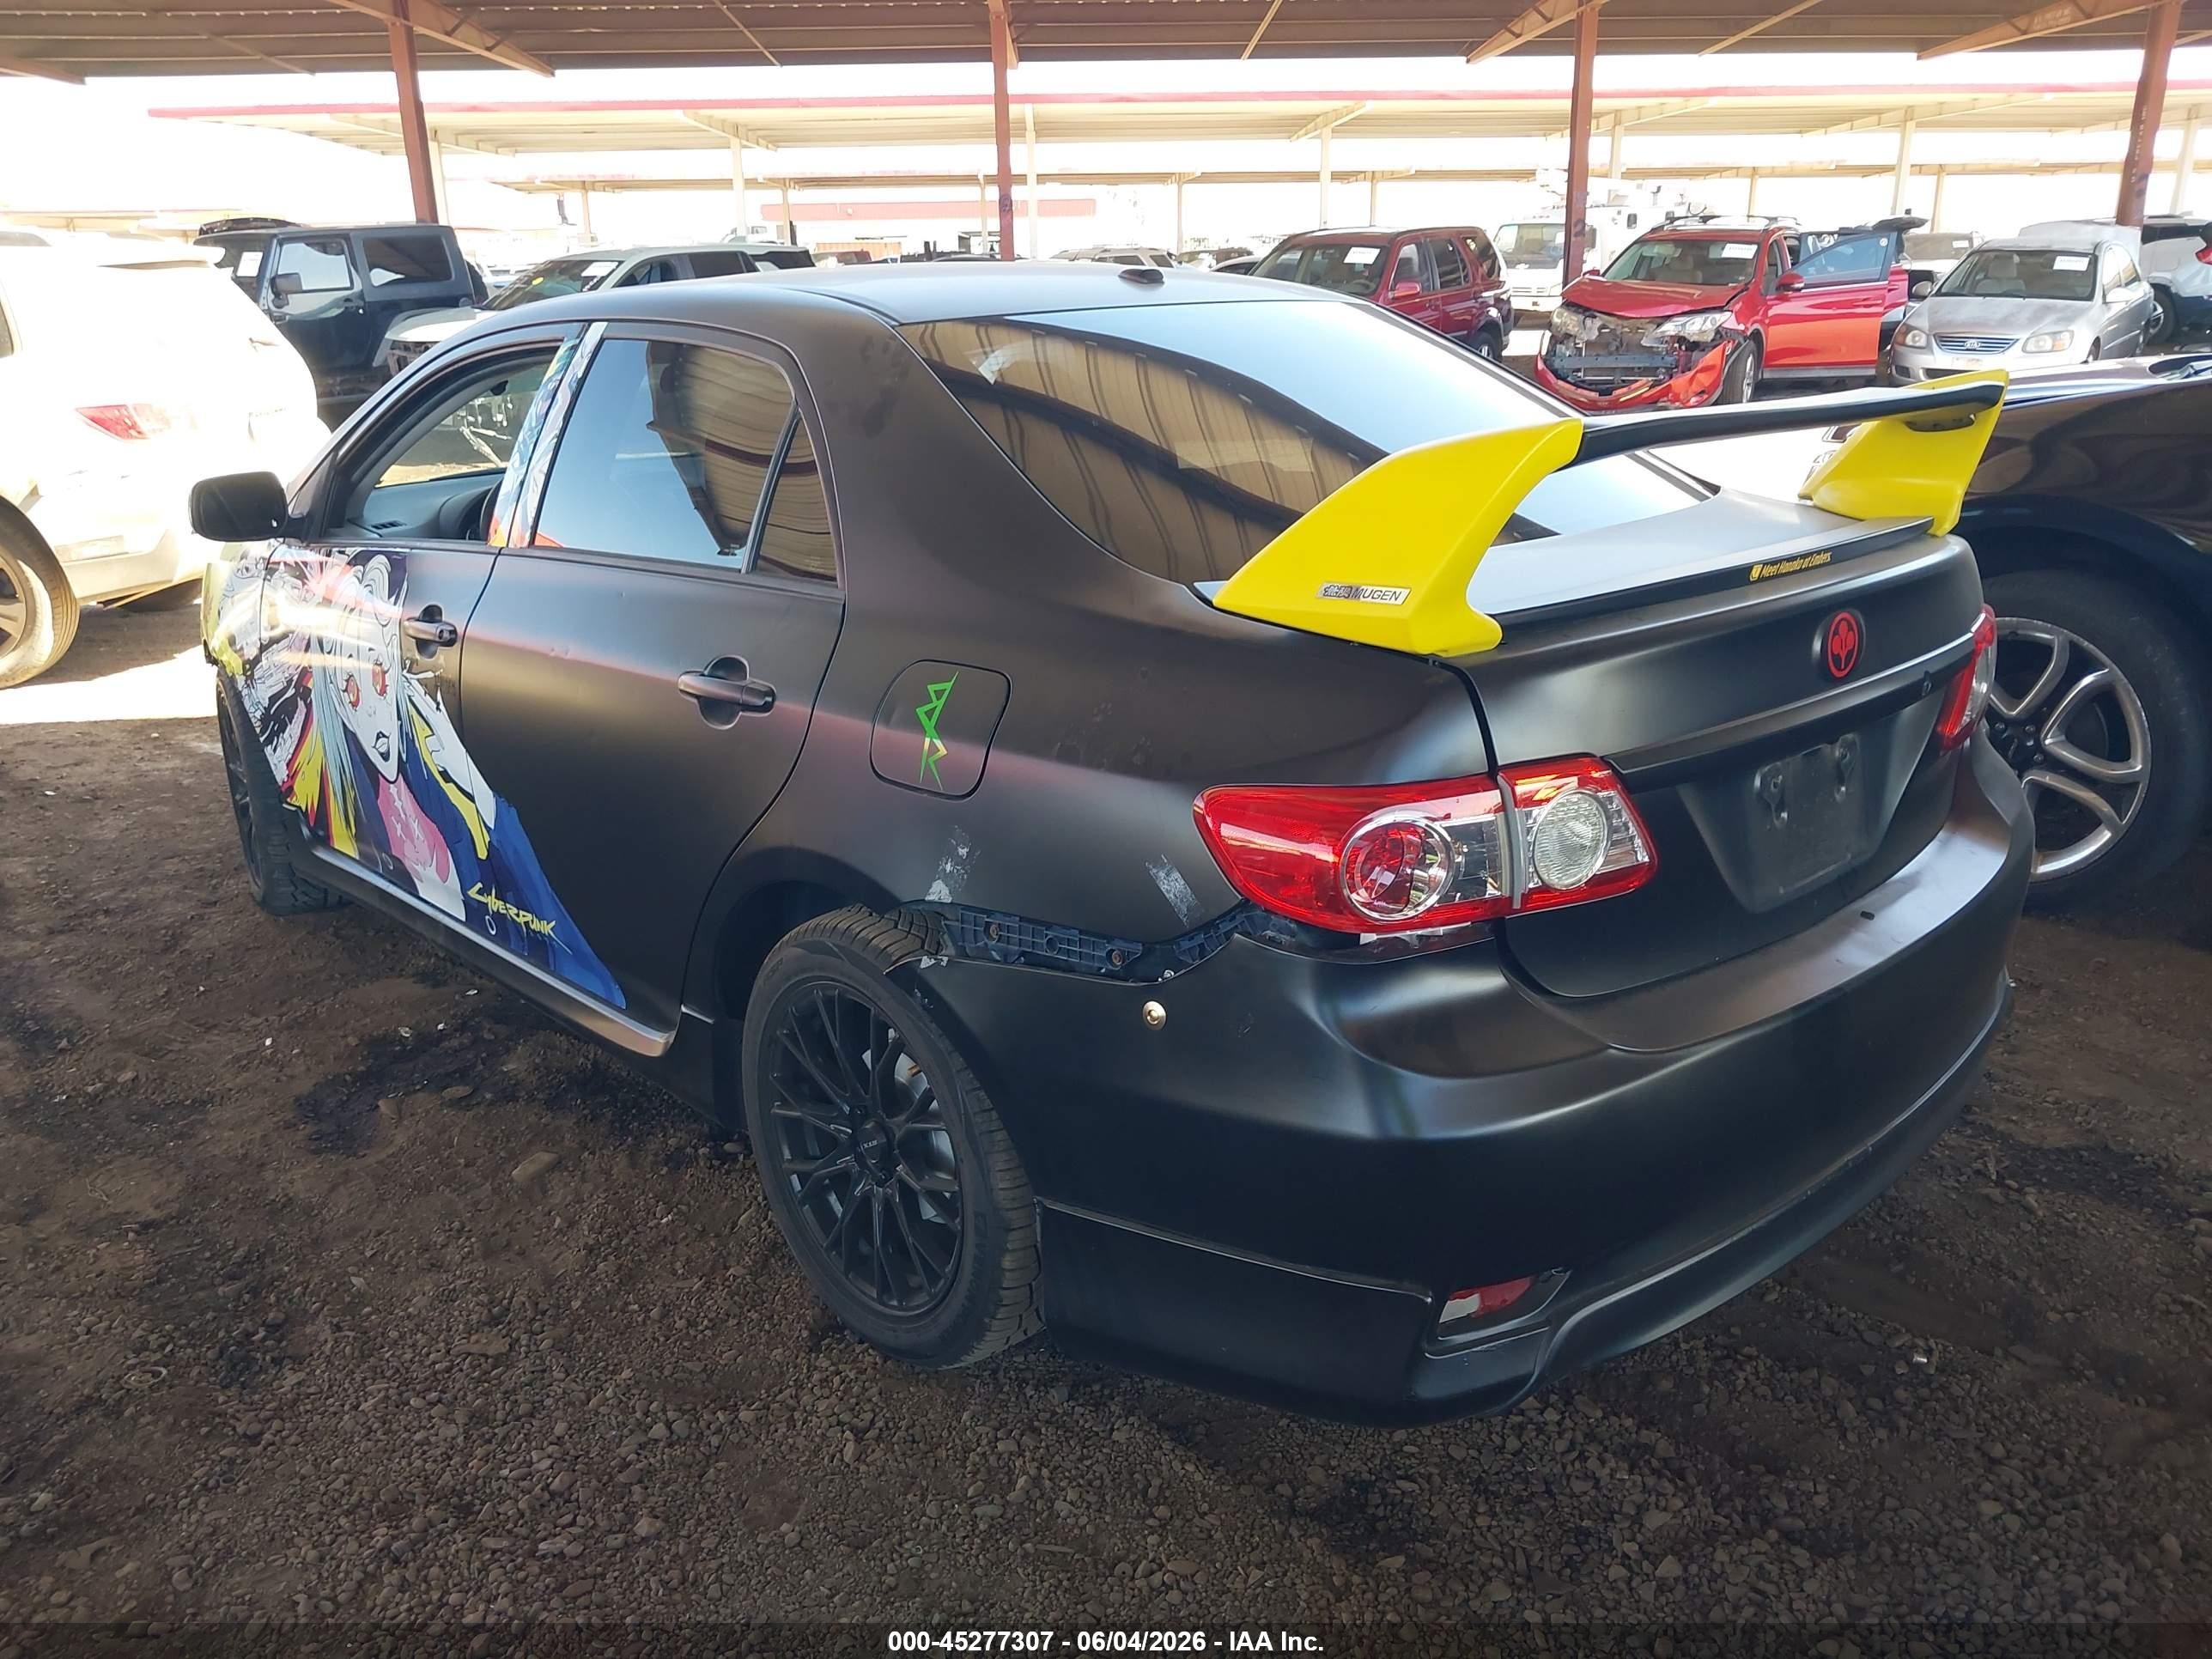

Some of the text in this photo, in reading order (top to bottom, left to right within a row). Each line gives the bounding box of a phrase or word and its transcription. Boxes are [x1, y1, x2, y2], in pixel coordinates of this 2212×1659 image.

[1759, 562, 1780, 579] Meet
[1808, 550, 1832, 568] Embers
[1351, 586, 1402, 602] MUGEN
